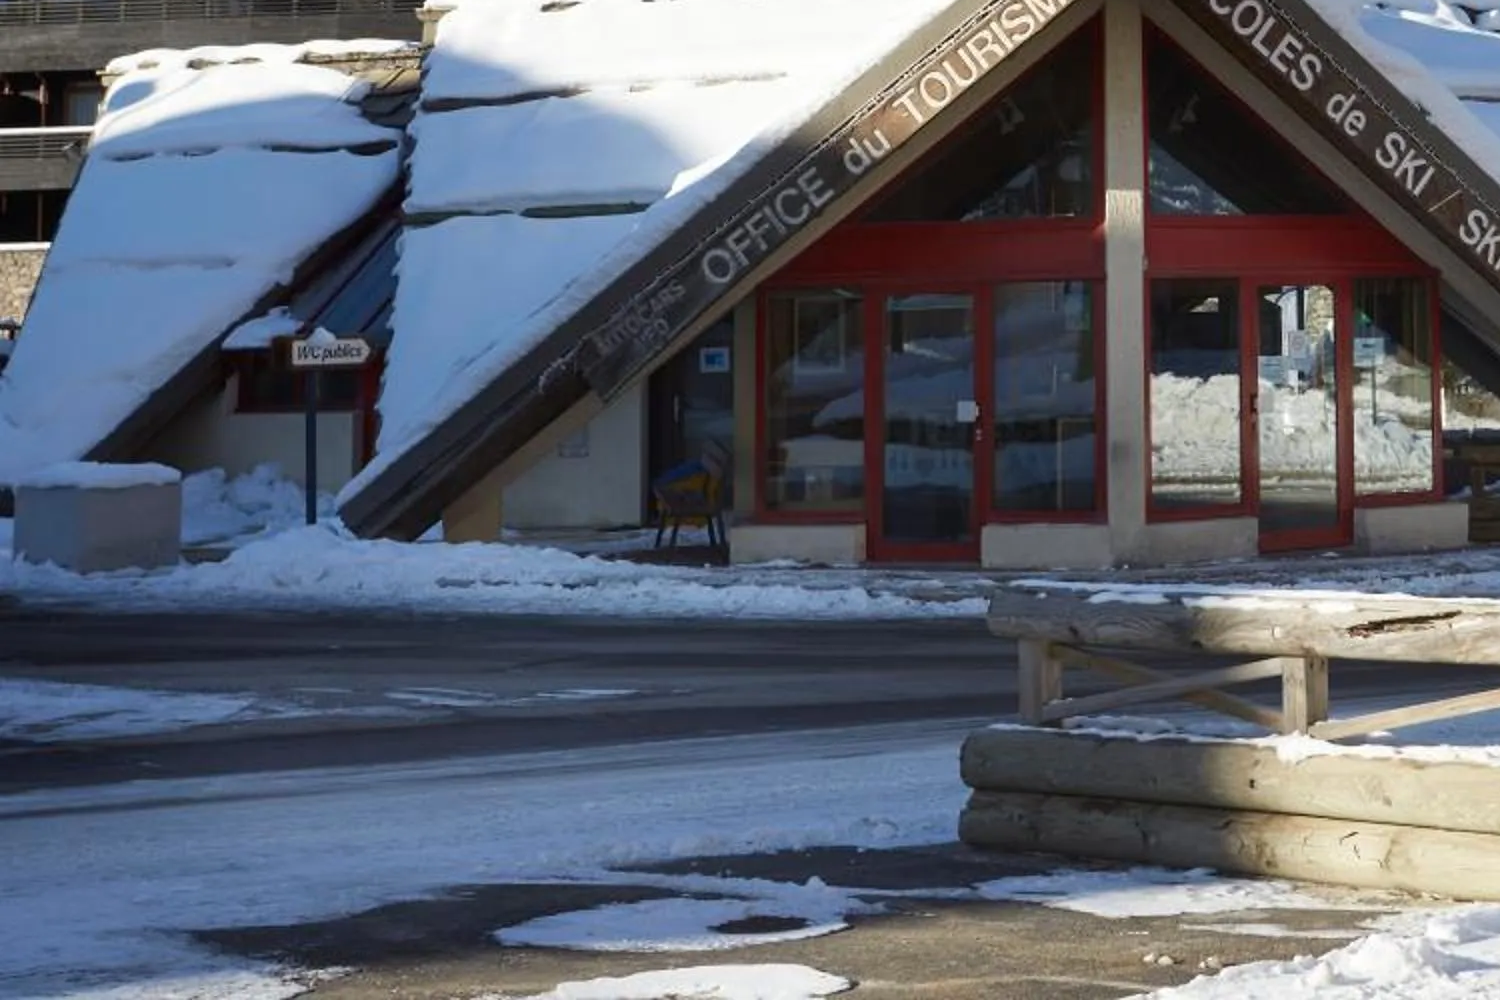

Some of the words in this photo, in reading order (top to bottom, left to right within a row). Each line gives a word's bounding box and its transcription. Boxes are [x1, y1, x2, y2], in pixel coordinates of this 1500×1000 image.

[702, 166, 835, 283] OFFICE
[844, 128, 892, 175] du
[1325, 92, 1367, 137] de
[1375, 132, 1436, 197] SKI
